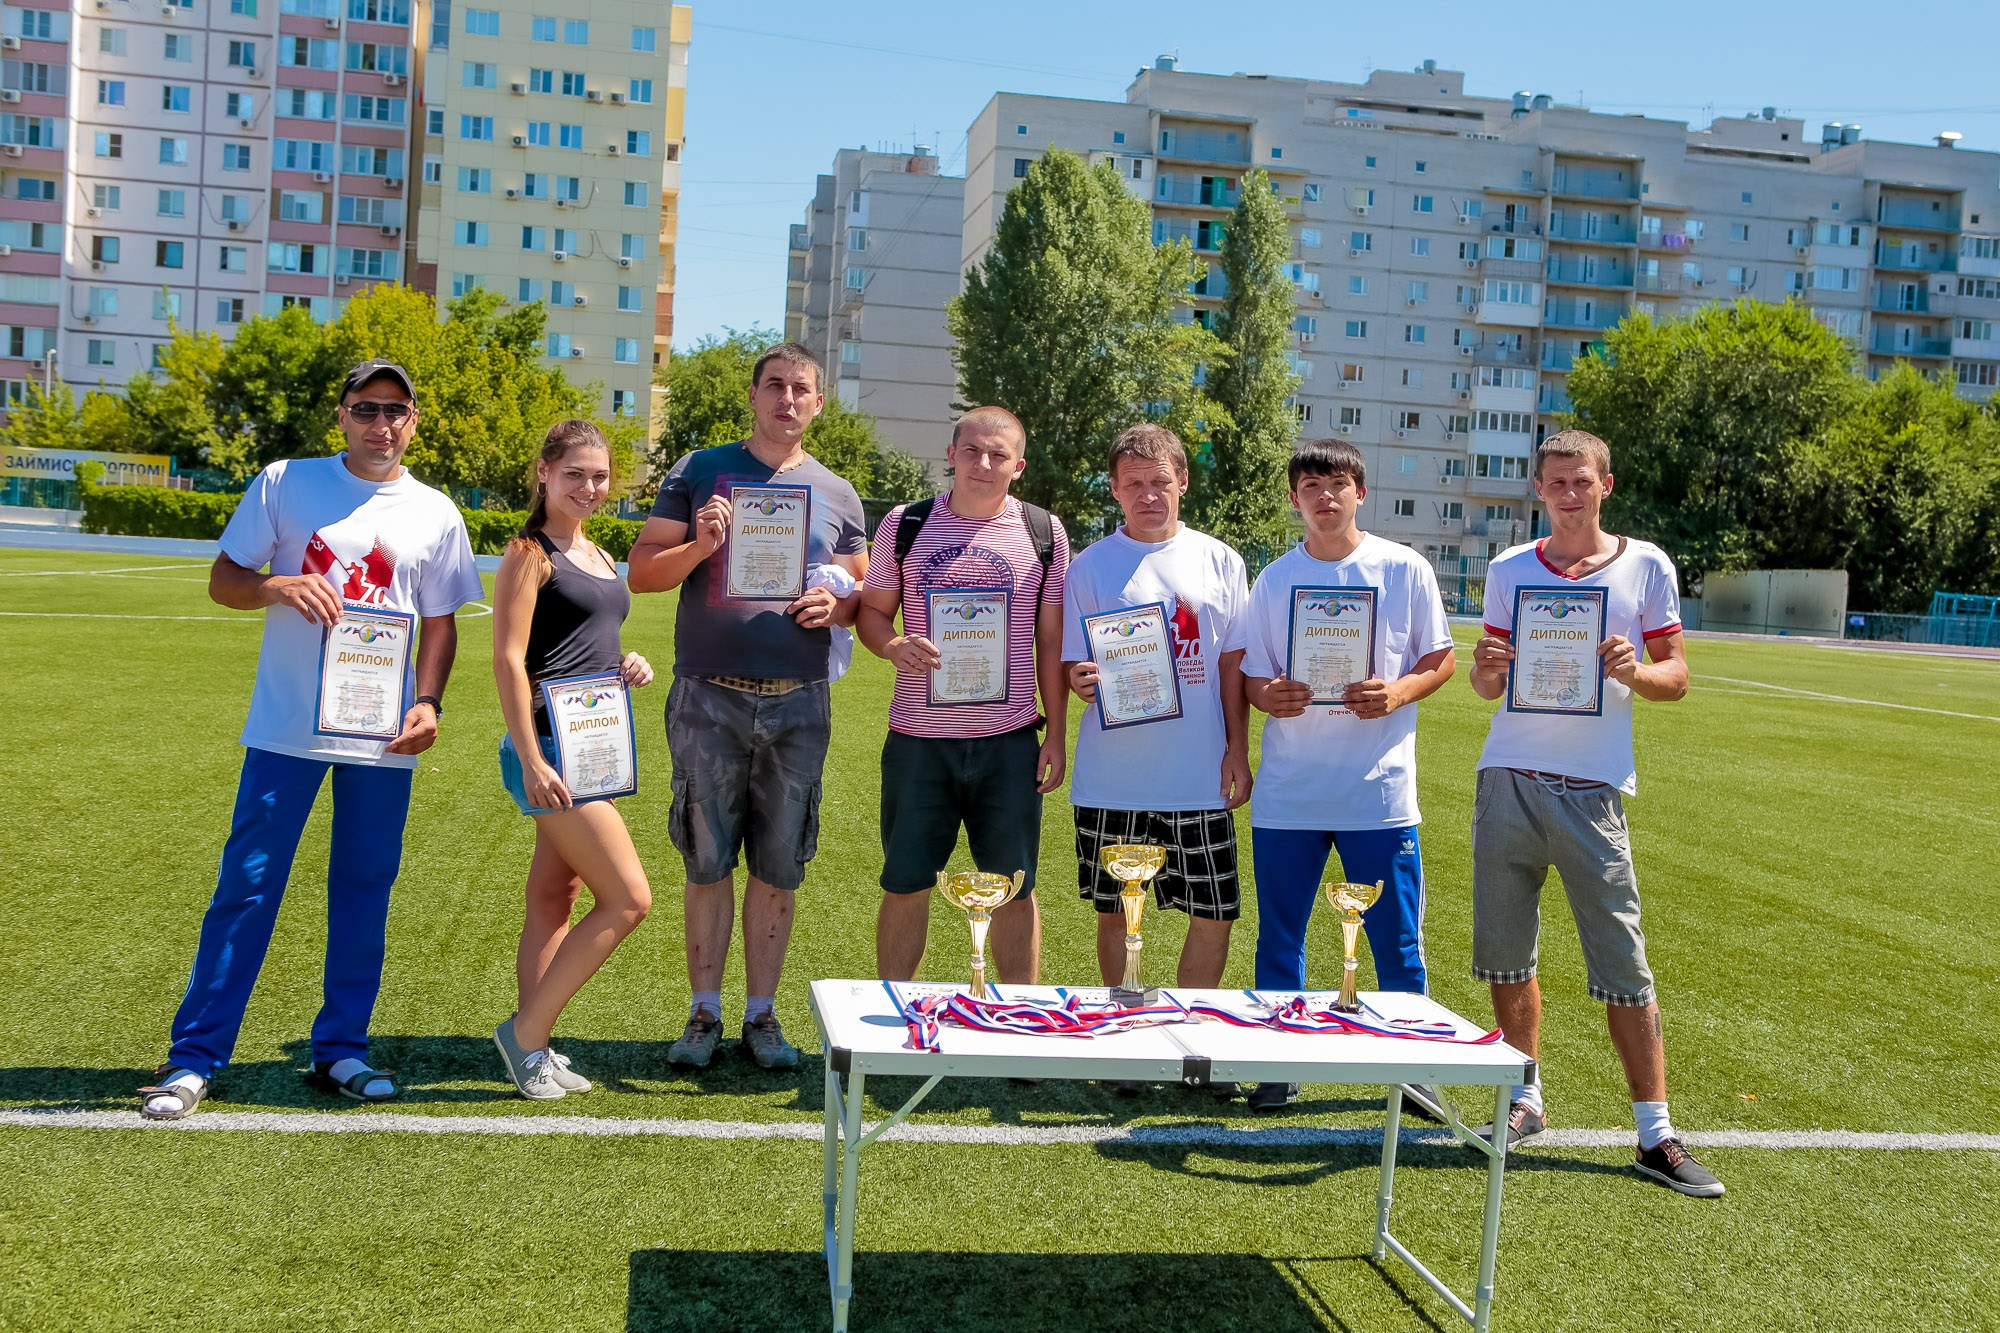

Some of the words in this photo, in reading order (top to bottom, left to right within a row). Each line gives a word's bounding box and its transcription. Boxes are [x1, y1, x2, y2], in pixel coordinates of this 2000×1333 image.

[99, 461, 165, 476] ОРТОМ!
[742, 525, 795, 536] ДИПЛОМ
[943, 630, 996, 642] ДИПЛОМ
[1305, 626, 1360, 638] ДИПЛОМ
[1529, 629, 1588, 641] ДИПЛОМ
[1105, 642, 1159, 662] ДИПЛОМ
[1176, 638, 1201, 660] 70
[337, 651, 394, 668] ДИПЛОМ
[1178, 672, 1205, 680] ственной
[569, 715, 620, 734] ДИПЛОМ
